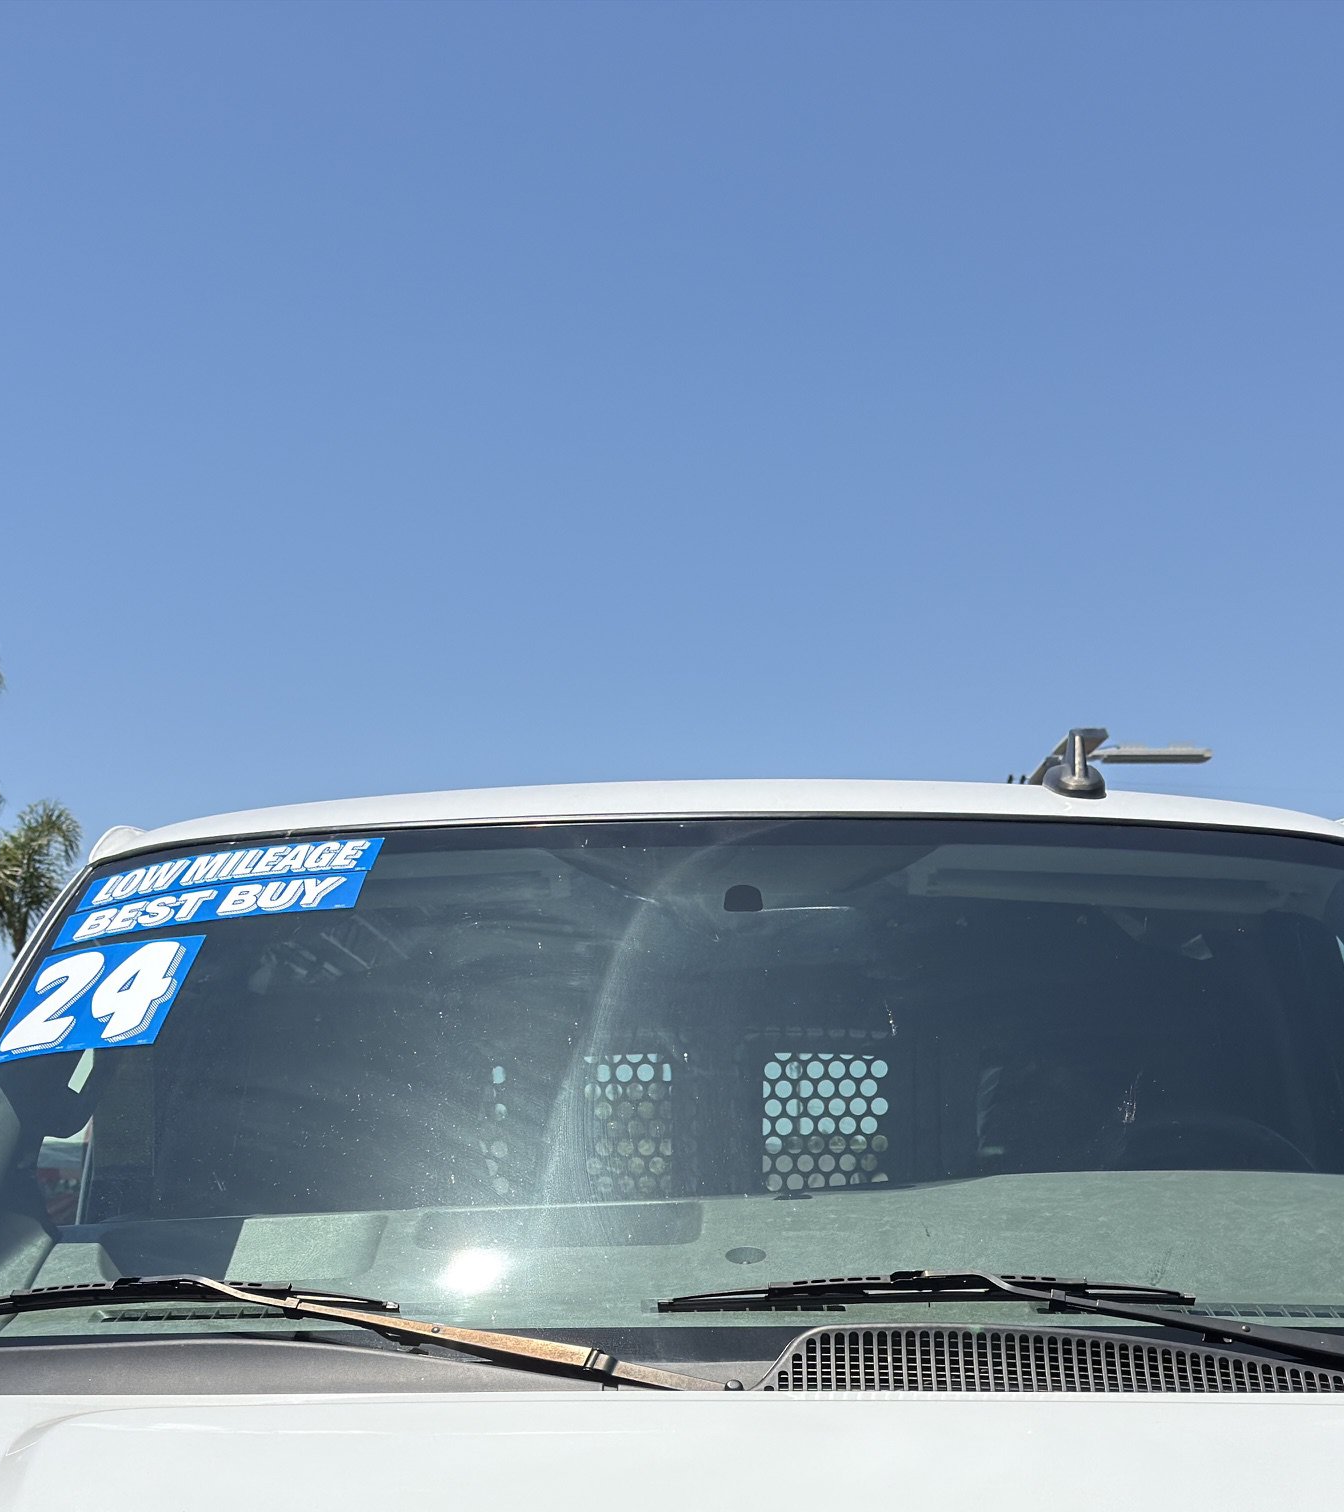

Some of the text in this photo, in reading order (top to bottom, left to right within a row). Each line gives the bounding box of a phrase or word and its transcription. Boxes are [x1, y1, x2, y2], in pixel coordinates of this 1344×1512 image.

[91, 839, 371, 906] LOW MILEAGE
[72, 875, 347, 942] BEST BUY
[0, 940, 186, 1055] 24
